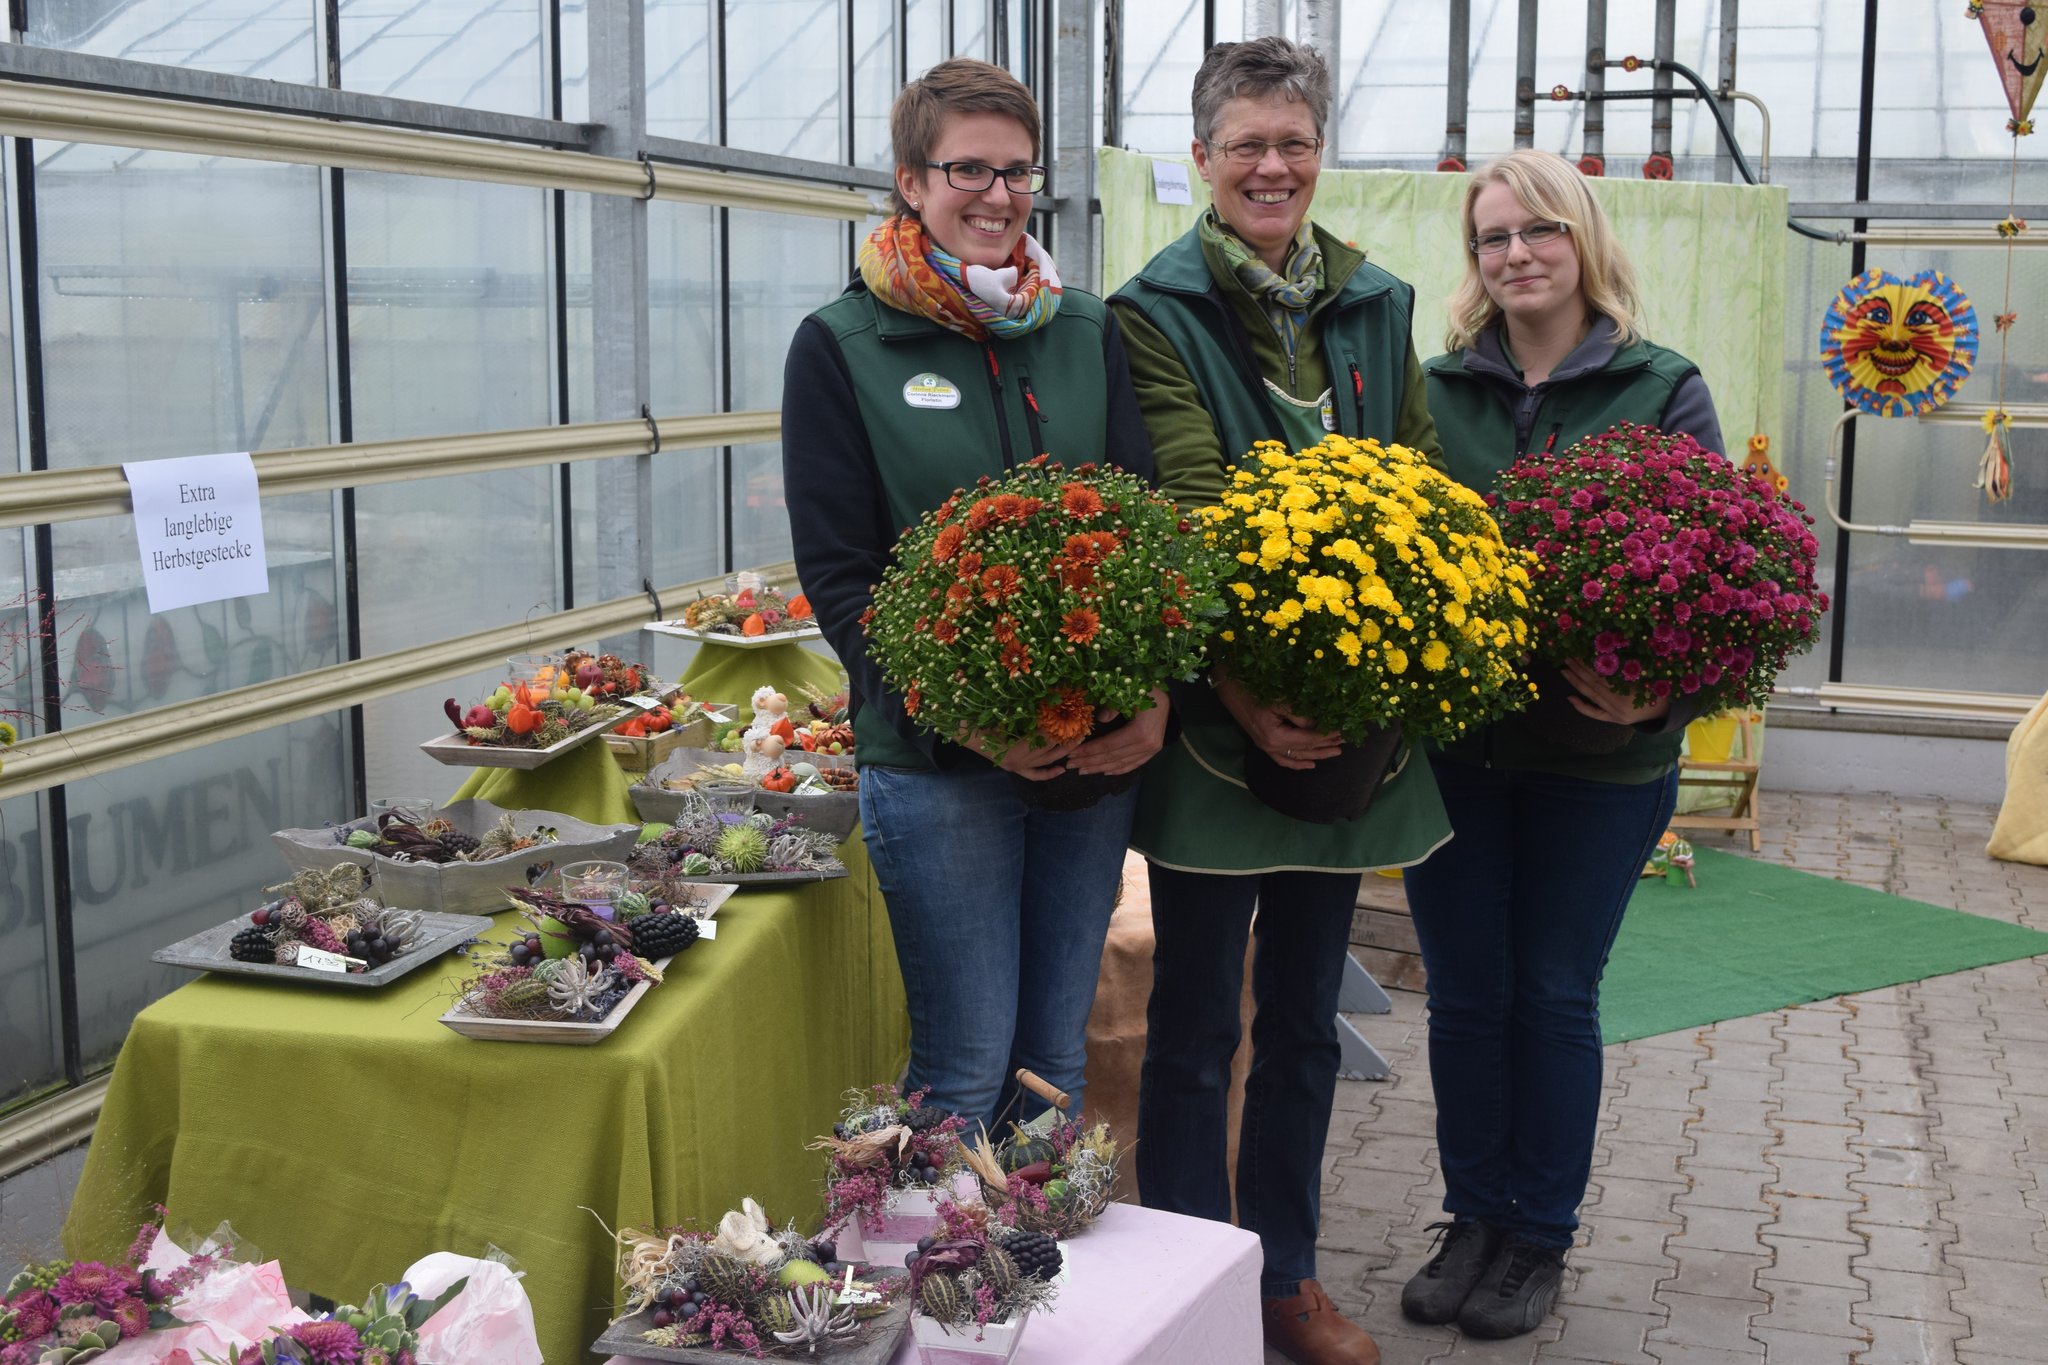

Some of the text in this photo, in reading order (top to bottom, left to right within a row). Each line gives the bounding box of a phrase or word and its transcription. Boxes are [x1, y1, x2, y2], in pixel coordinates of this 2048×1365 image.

[179, 483, 216, 504] Extra
[164, 511, 233, 540] langlebige
[152, 539, 253, 572] Herbstgestecke
